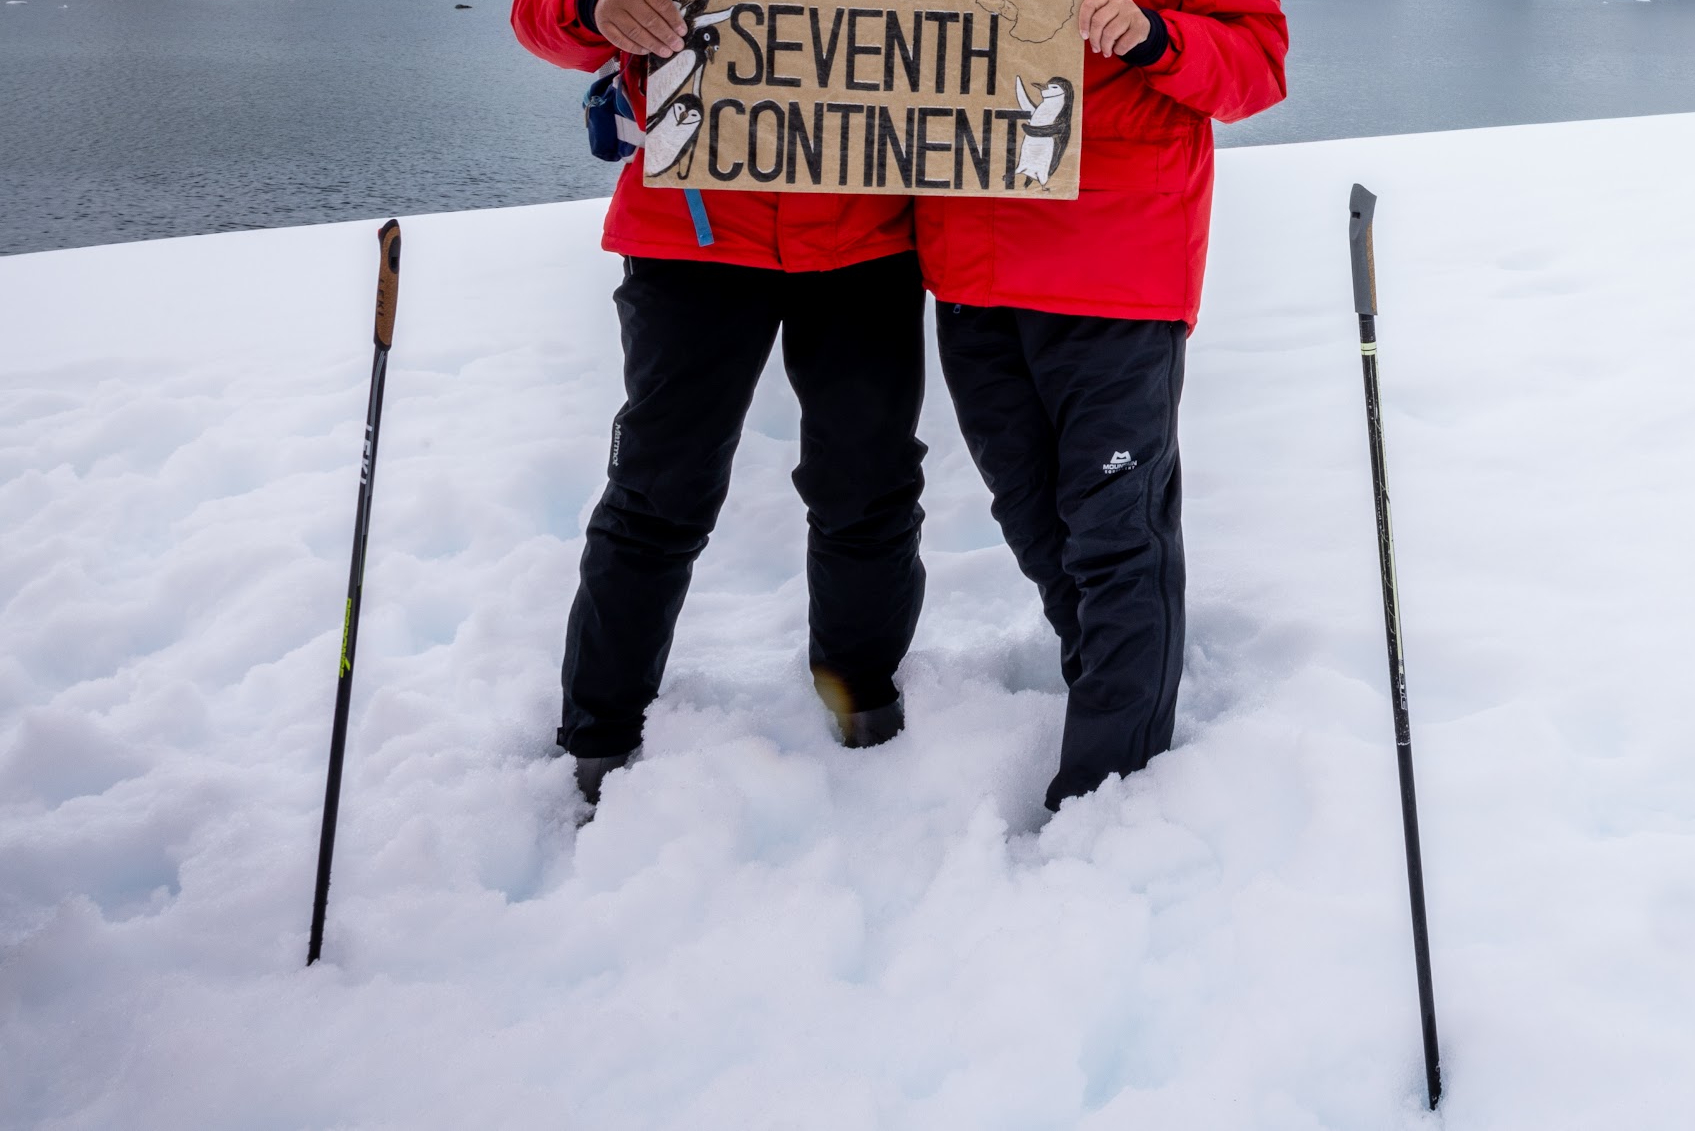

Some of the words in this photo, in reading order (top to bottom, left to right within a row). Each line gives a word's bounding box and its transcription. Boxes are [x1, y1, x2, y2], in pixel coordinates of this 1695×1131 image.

[726, 2, 999, 96] SEVENTH
[708, 98, 1032, 190] CONTINENT
[612, 422, 622, 467] Marmot
